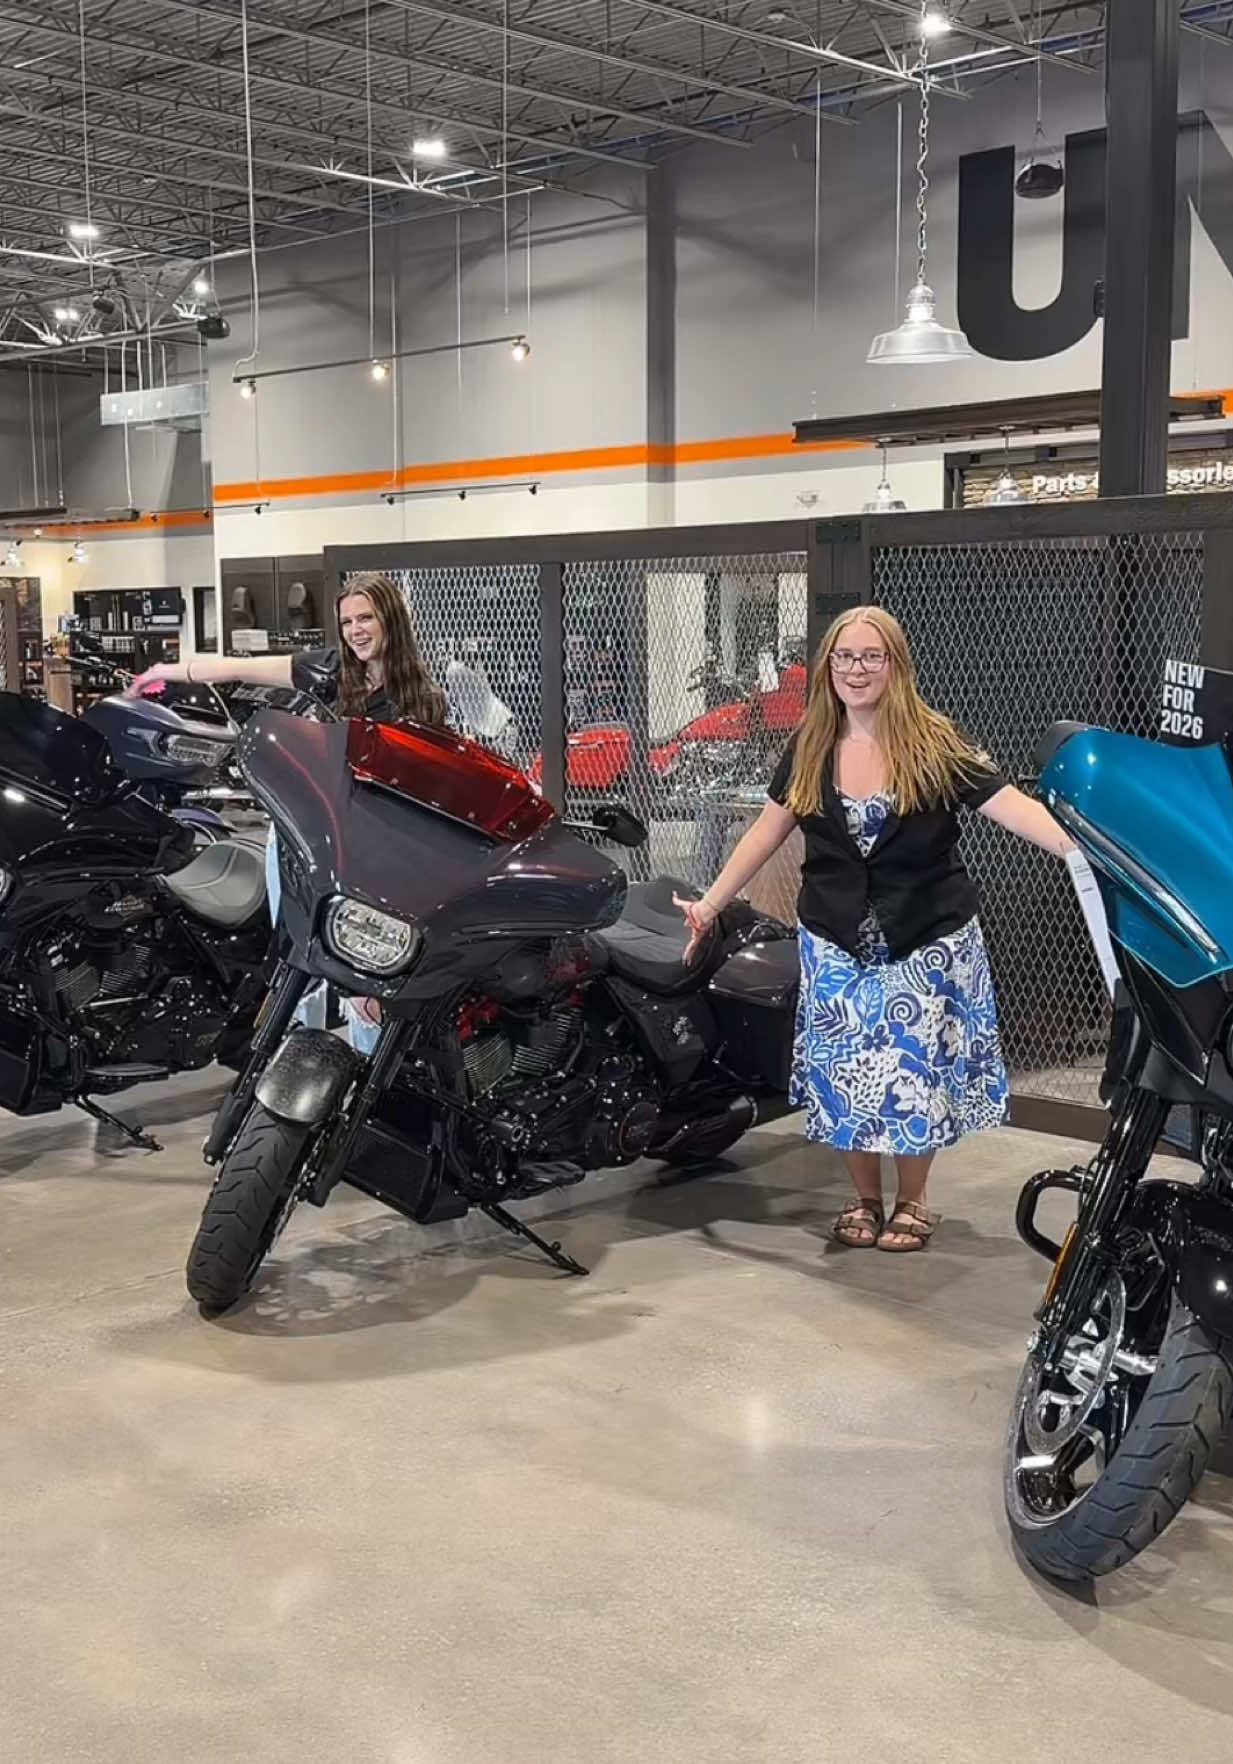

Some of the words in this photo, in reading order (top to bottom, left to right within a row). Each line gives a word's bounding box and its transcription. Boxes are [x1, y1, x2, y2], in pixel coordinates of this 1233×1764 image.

[1032, 473, 1087, 493] Parts
[1167, 461, 1233, 485] ssorie
[1165, 659, 1205, 689] NEW
[1162, 684, 1195, 713] FOR
[1160, 709, 1204, 740] 2026
